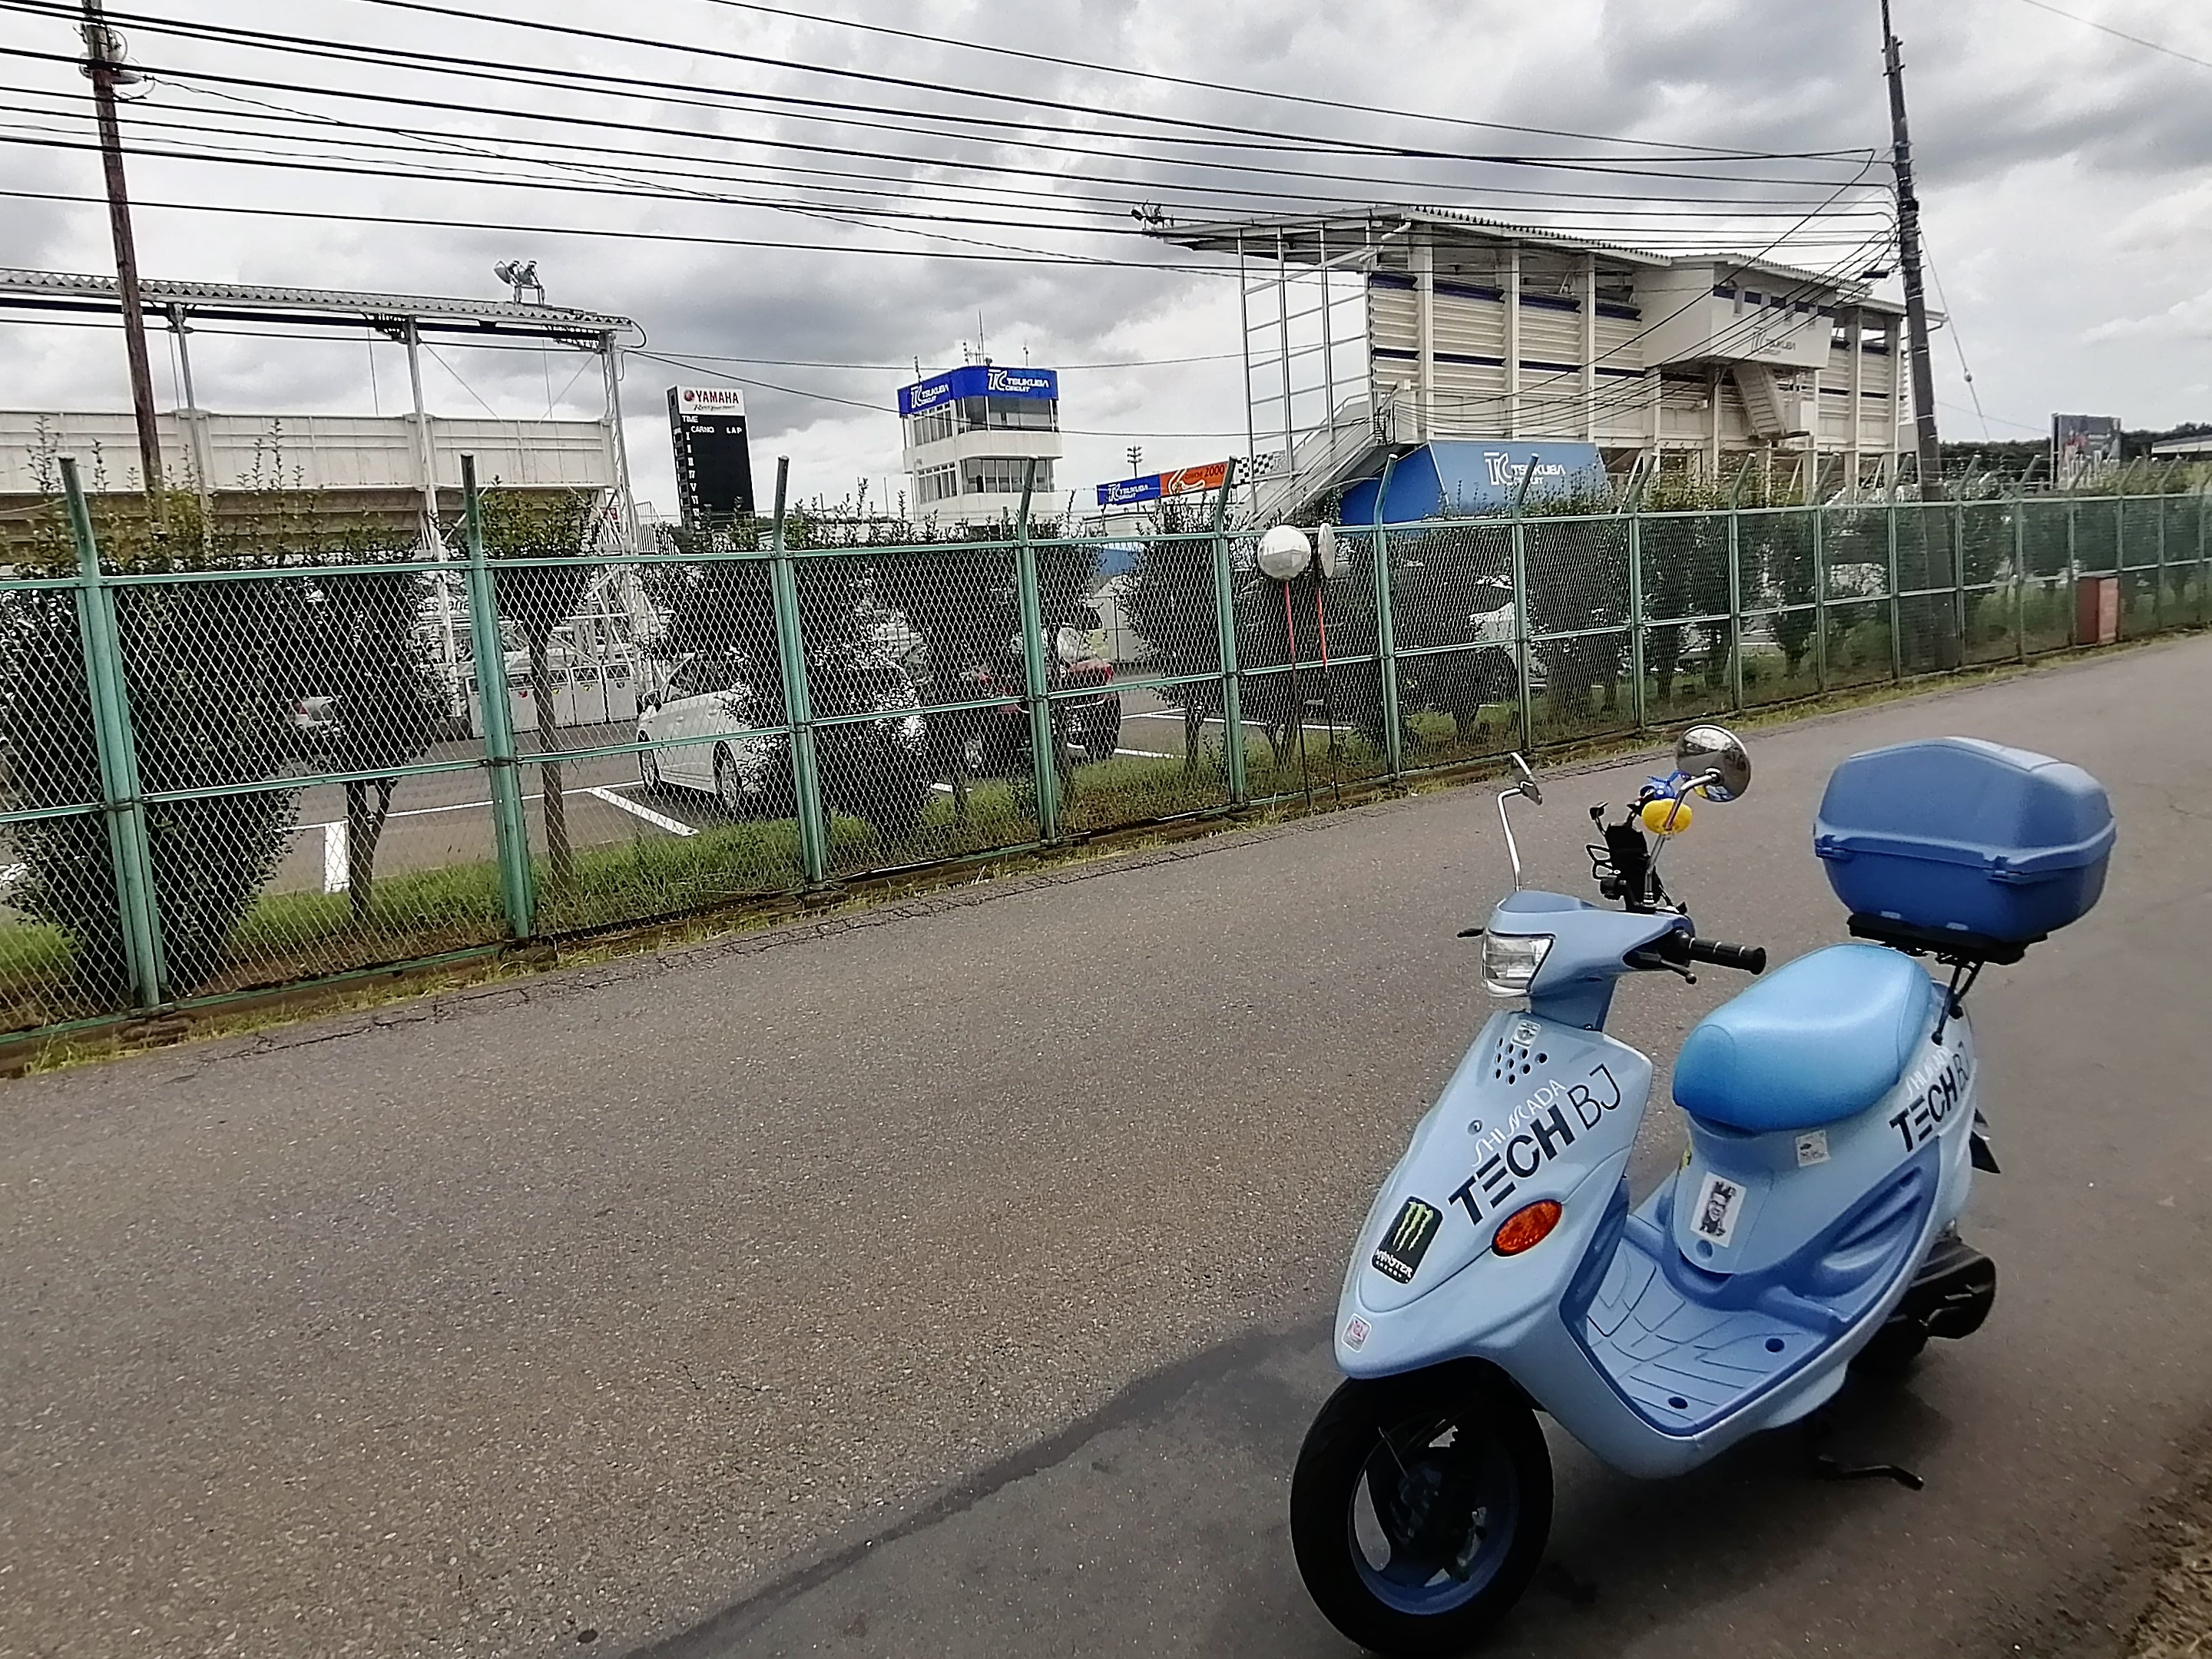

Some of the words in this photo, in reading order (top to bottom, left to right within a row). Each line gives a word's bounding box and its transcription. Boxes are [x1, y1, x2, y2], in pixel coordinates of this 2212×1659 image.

[988, 369, 1008, 391] TC
[1007, 379, 1049, 388] TSUKUBA
[695, 390, 739, 404] YAMAHA
[1204, 464, 1225, 477] 2000
[1483, 452, 1512, 485] TC
[1510, 464, 1566, 475] TSKUBA
[1889, 1065, 1958, 1152] TECH
[1448, 1104, 1575, 1226] TECH
[1567, 1063, 1621, 1131] BJ
[1375, 1249, 1413, 1278] MONSTER
